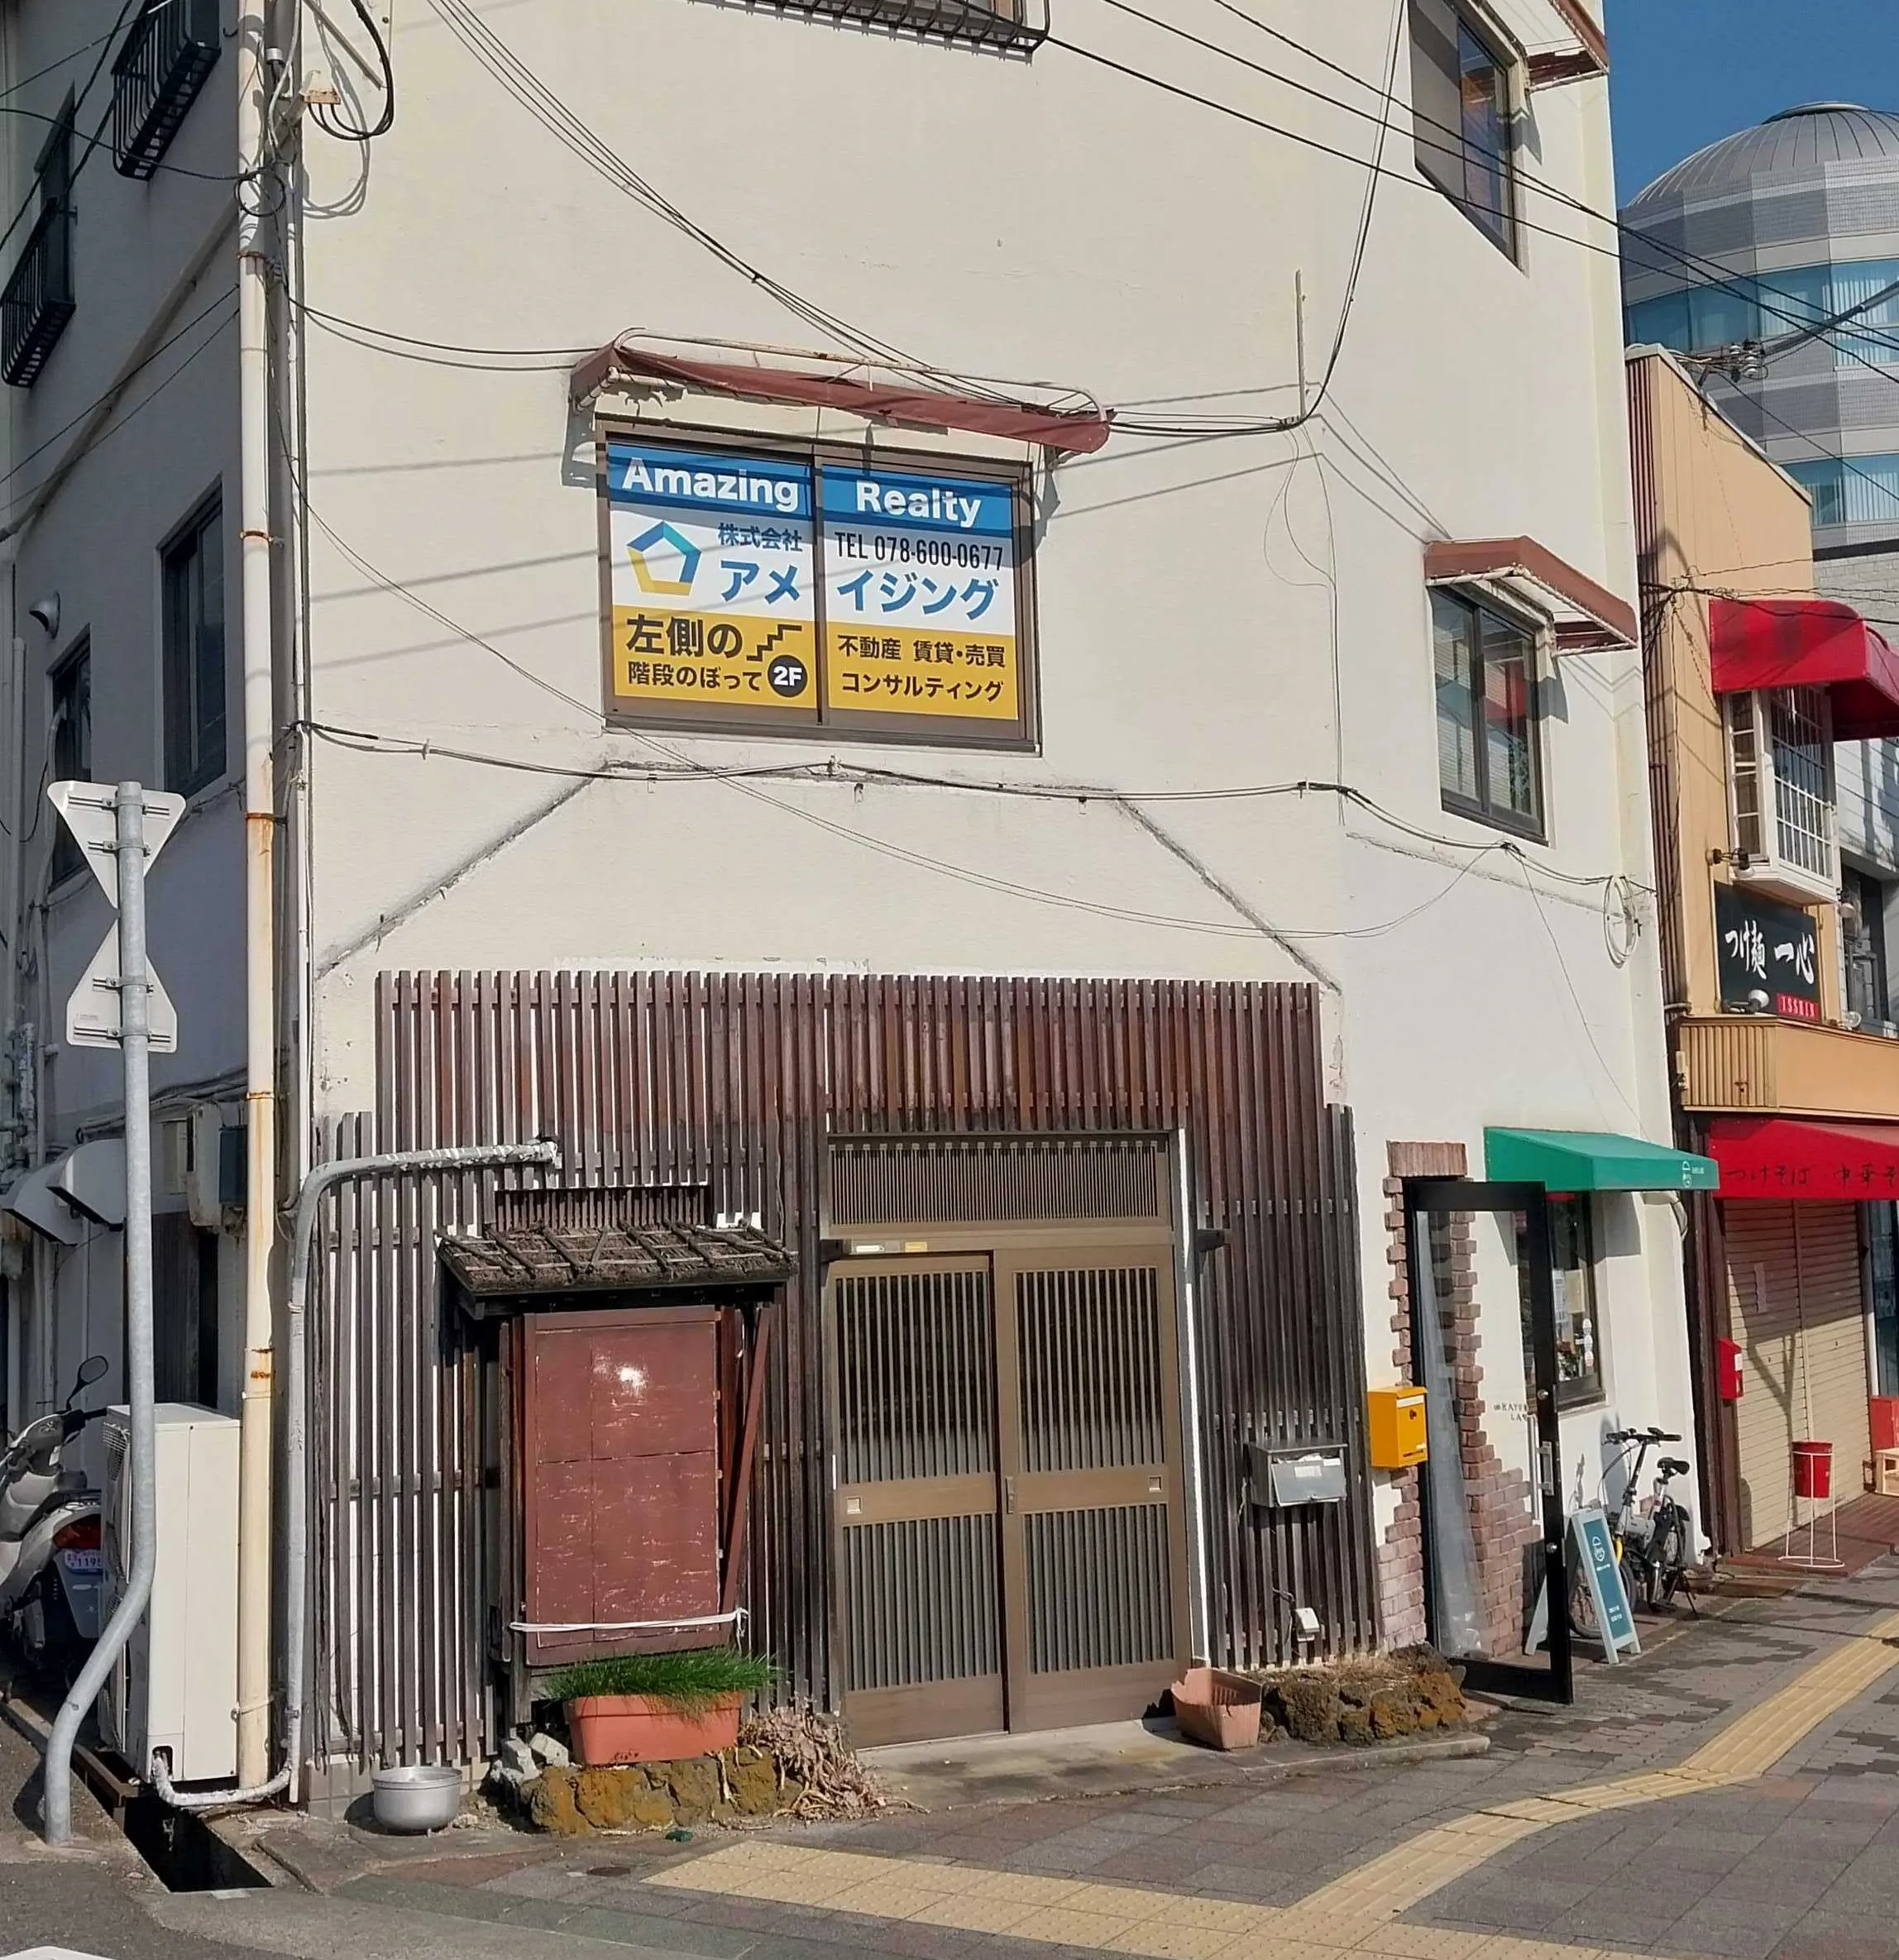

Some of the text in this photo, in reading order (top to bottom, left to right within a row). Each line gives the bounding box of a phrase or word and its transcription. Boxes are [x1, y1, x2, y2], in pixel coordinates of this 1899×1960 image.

[622, 458, 981, 528] Amazing Realty
[719, 523, 803, 552] 株式会社
[835, 532, 1003, 571] TEL 078-600-0677
[627, 614, 744, 658] 左側の
[838, 635, 1006, 667] 不動産 賃貸・売買
[629, 662, 802, 691] 階段のぼって 2F
[842, 672, 1003, 702] コンサルティング
[1774, 932, 1815, 984] 一心
[1725, 1164, 1809, 1185] つけそば
